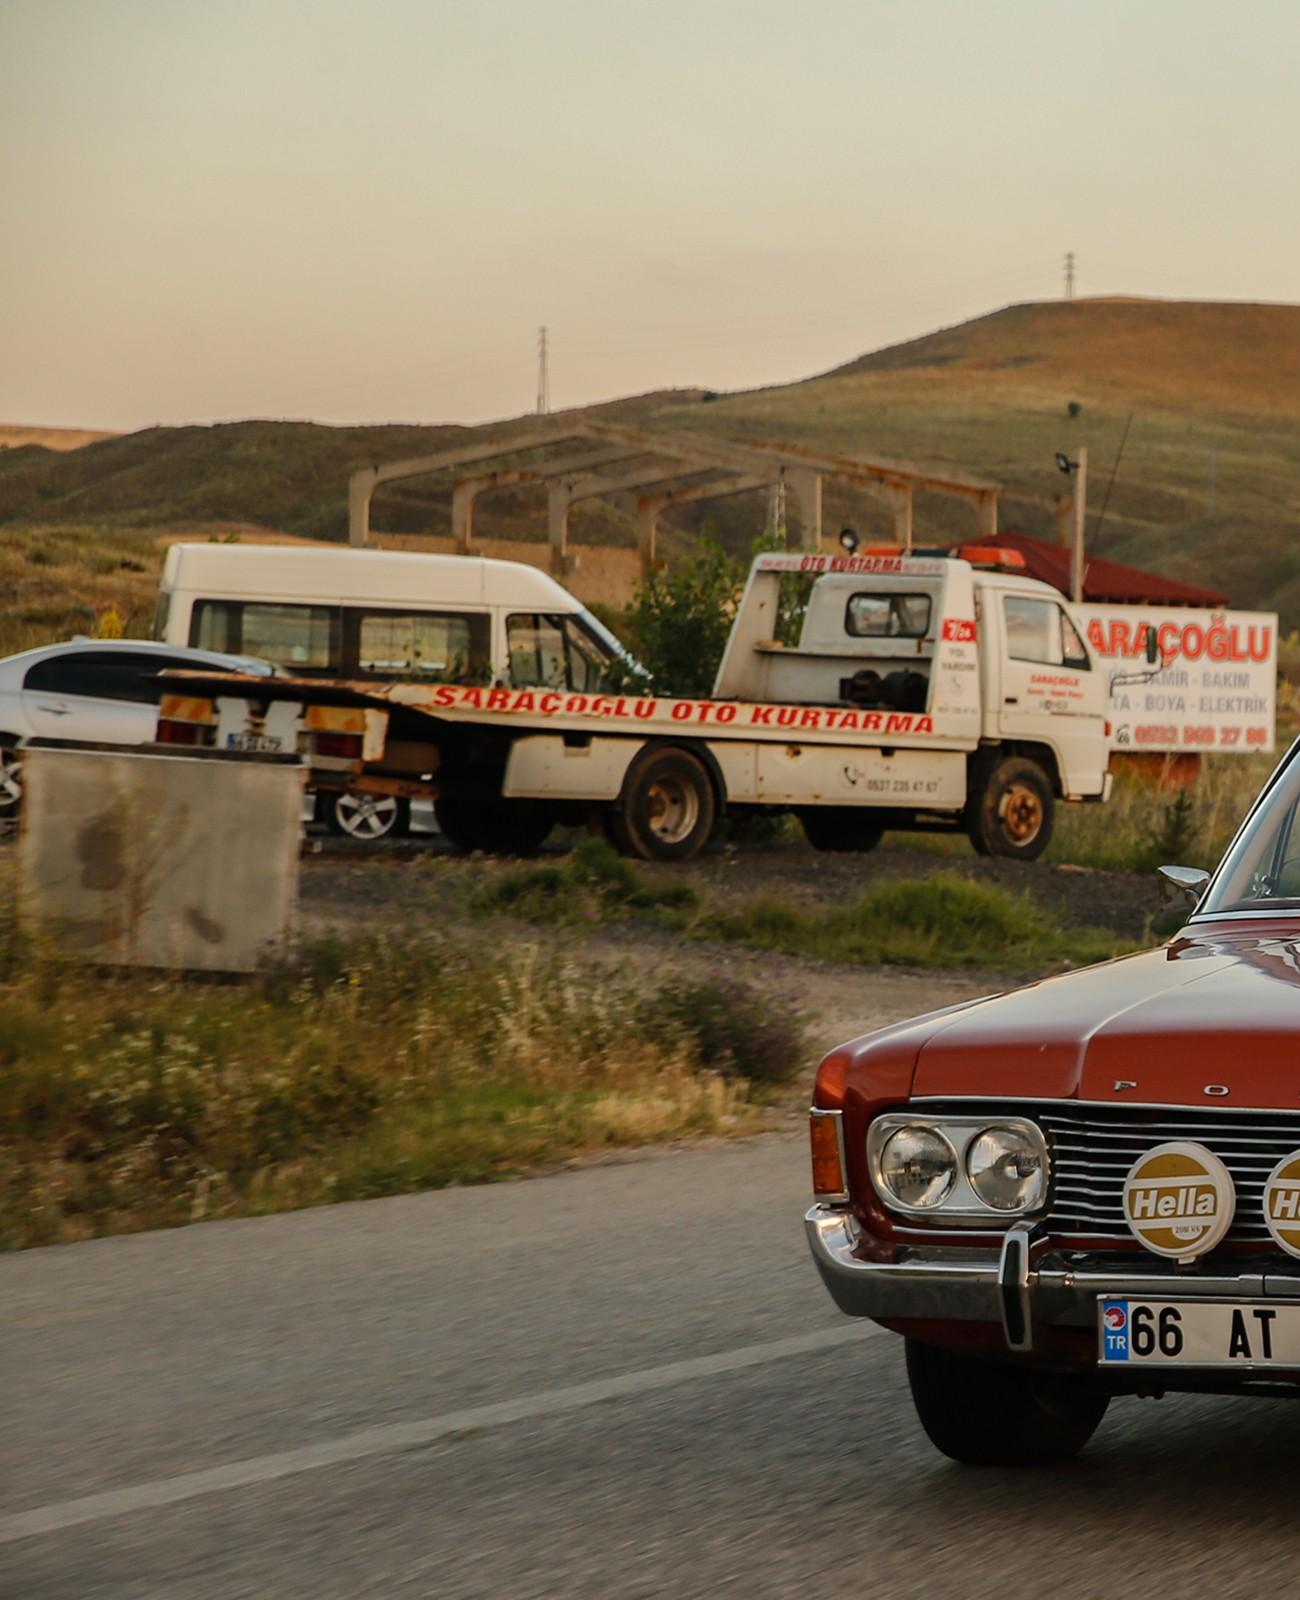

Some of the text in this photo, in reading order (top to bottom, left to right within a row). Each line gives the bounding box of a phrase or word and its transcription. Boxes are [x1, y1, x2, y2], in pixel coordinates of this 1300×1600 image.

[800, 556, 826, 571] OTO
[830, 557, 902, 572] KURTARMA
[1086, 614, 1273, 668] ARAÇOĞLU
[1202, 672, 1249, 689] BAKIM
[1145, 697, 1185, 711] BOYA
[1201, 695, 1267, 713] ELEKTRİK
[672, 701, 737, 724] OTO
[751, 706, 934, 734] KURTARMA
[1132, 1187, 1215, 1219] Hella
[1107, 1335, 1127, 1350] TR
[1131, 1306, 1183, 1357] 66
[1228, 1309, 1276, 1359] AT
